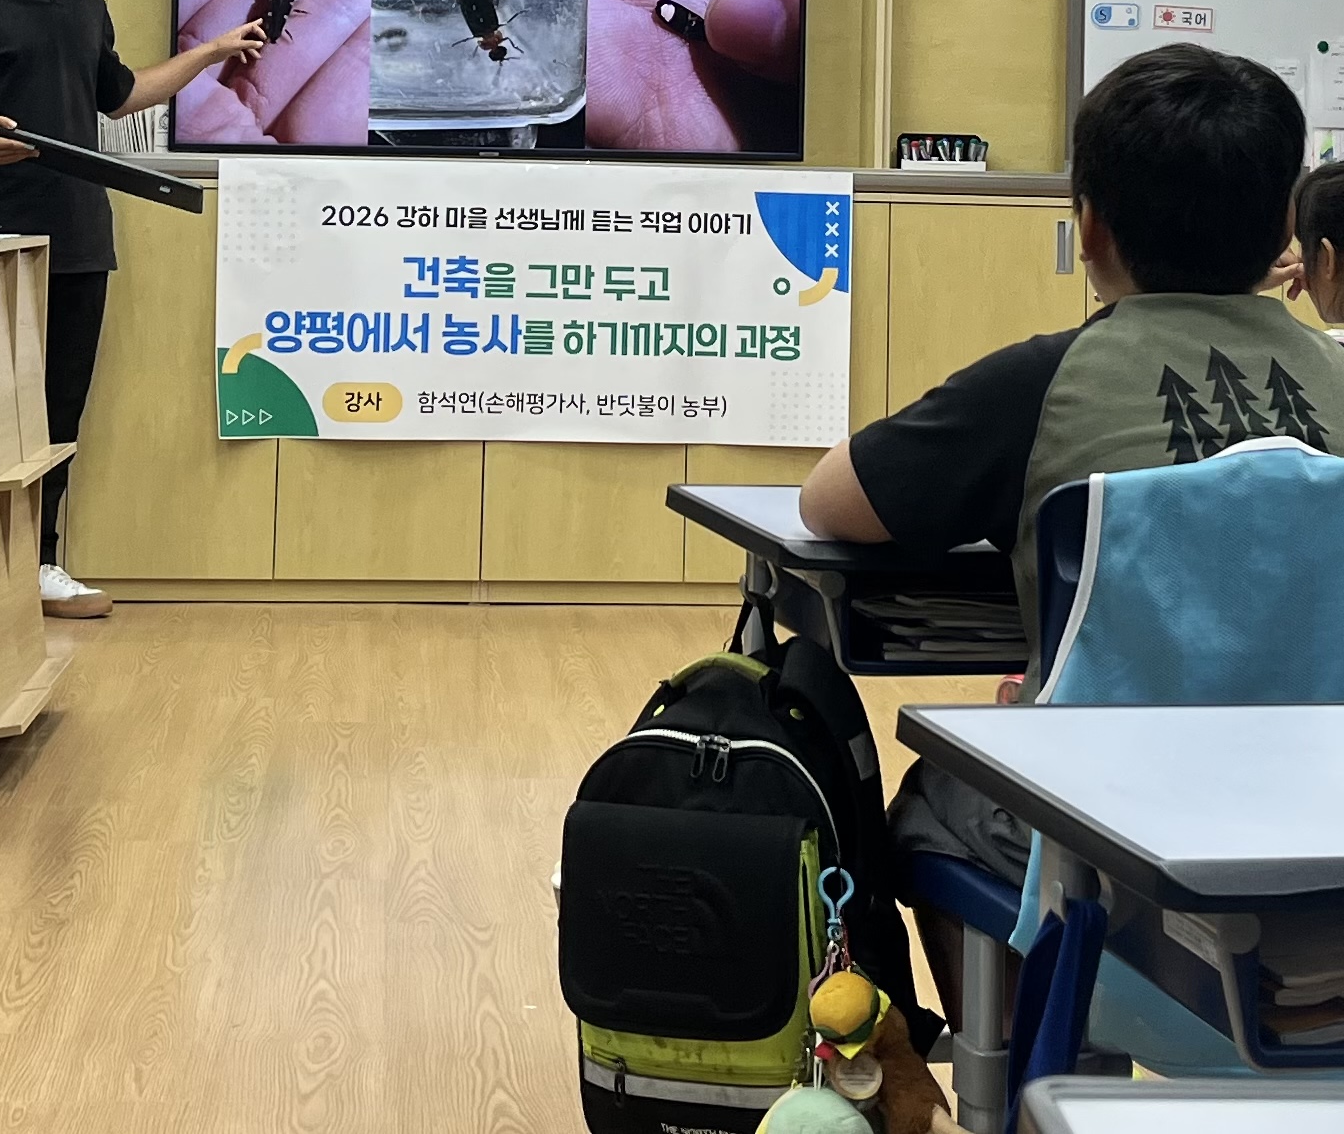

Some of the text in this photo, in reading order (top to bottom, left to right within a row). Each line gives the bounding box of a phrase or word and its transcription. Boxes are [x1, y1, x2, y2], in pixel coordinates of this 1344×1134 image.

[1181, 11, 1207, 27] 국어
[321, 205, 752, 235] 2026 강하 마을 선생님께 듣는 직업 이야기
[403, 255, 670, 301] 건축을 그만 두고
[265, 310, 801, 361] 양평에서 농사를 하기까지의 과정
[343, 390, 728, 418] 강사 함석연(손해평가사, 반딧불이 농부)
